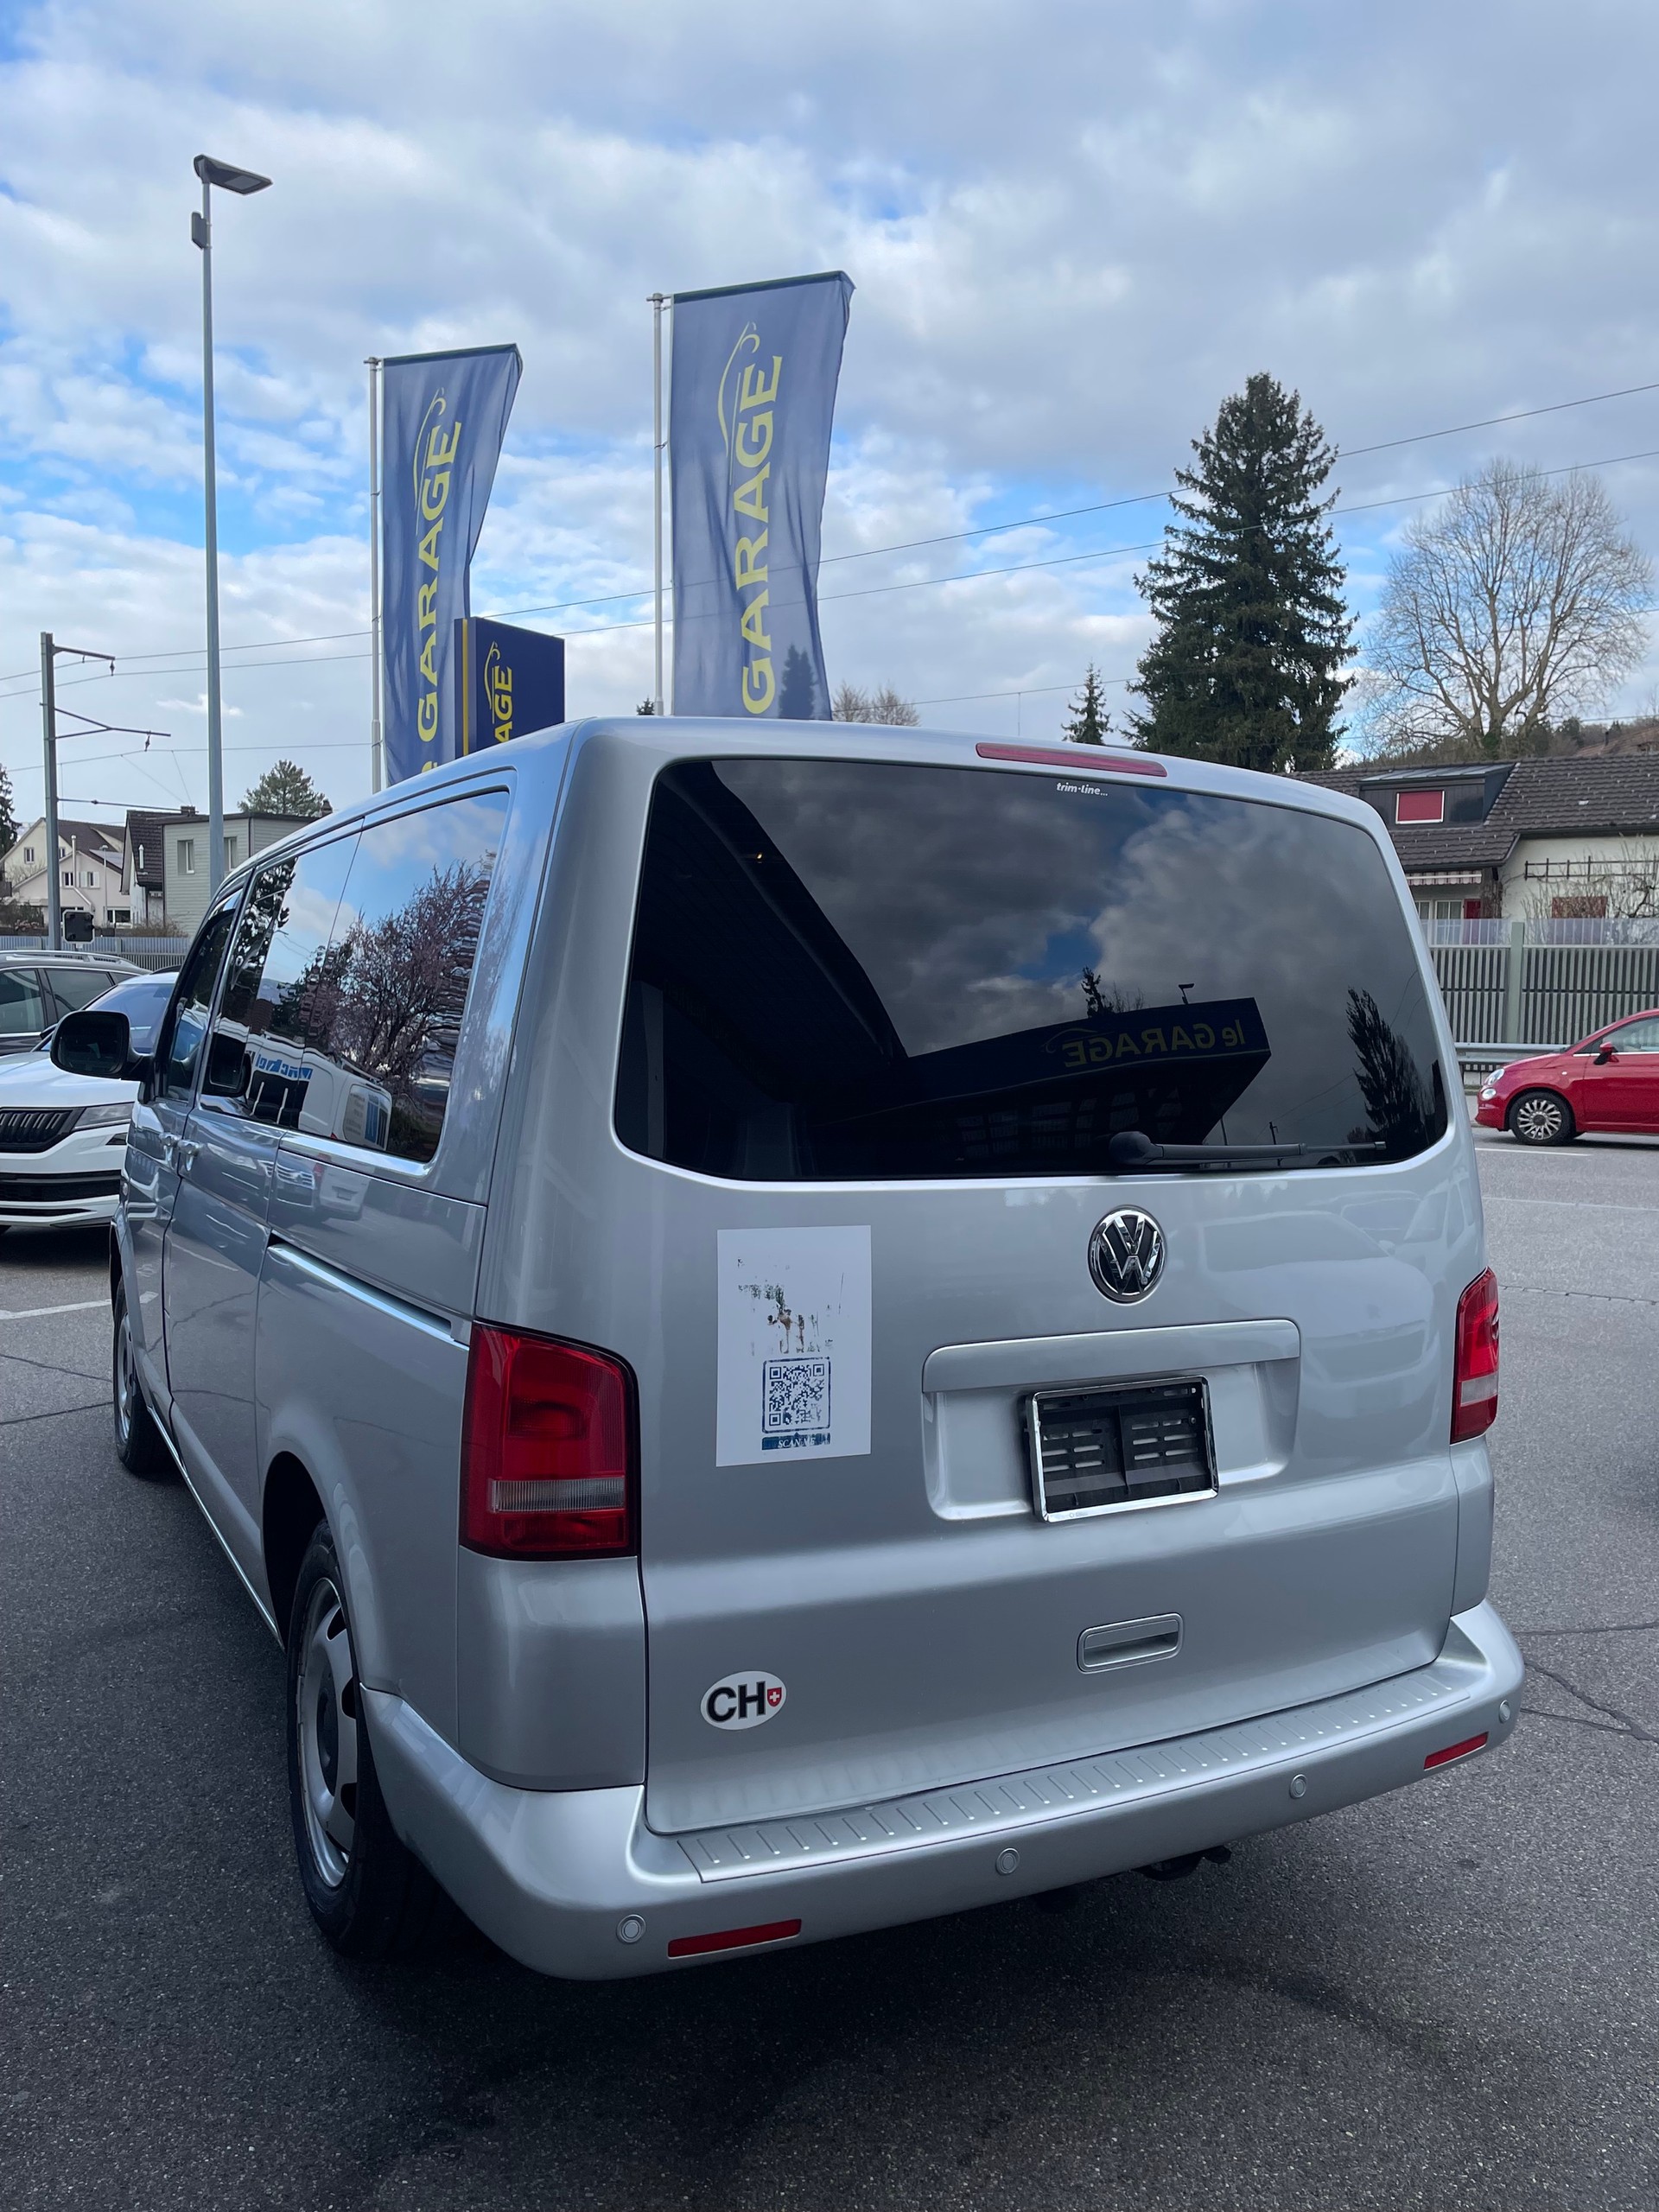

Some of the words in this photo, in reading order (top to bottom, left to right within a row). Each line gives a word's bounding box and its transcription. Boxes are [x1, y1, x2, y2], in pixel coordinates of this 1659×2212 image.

[417, 420, 462, 743] GARAGE
[733, 355, 783, 715] GARAGE
[494, 665, 513, 743] AGE
[706, 1680, 766, 1724] CH
